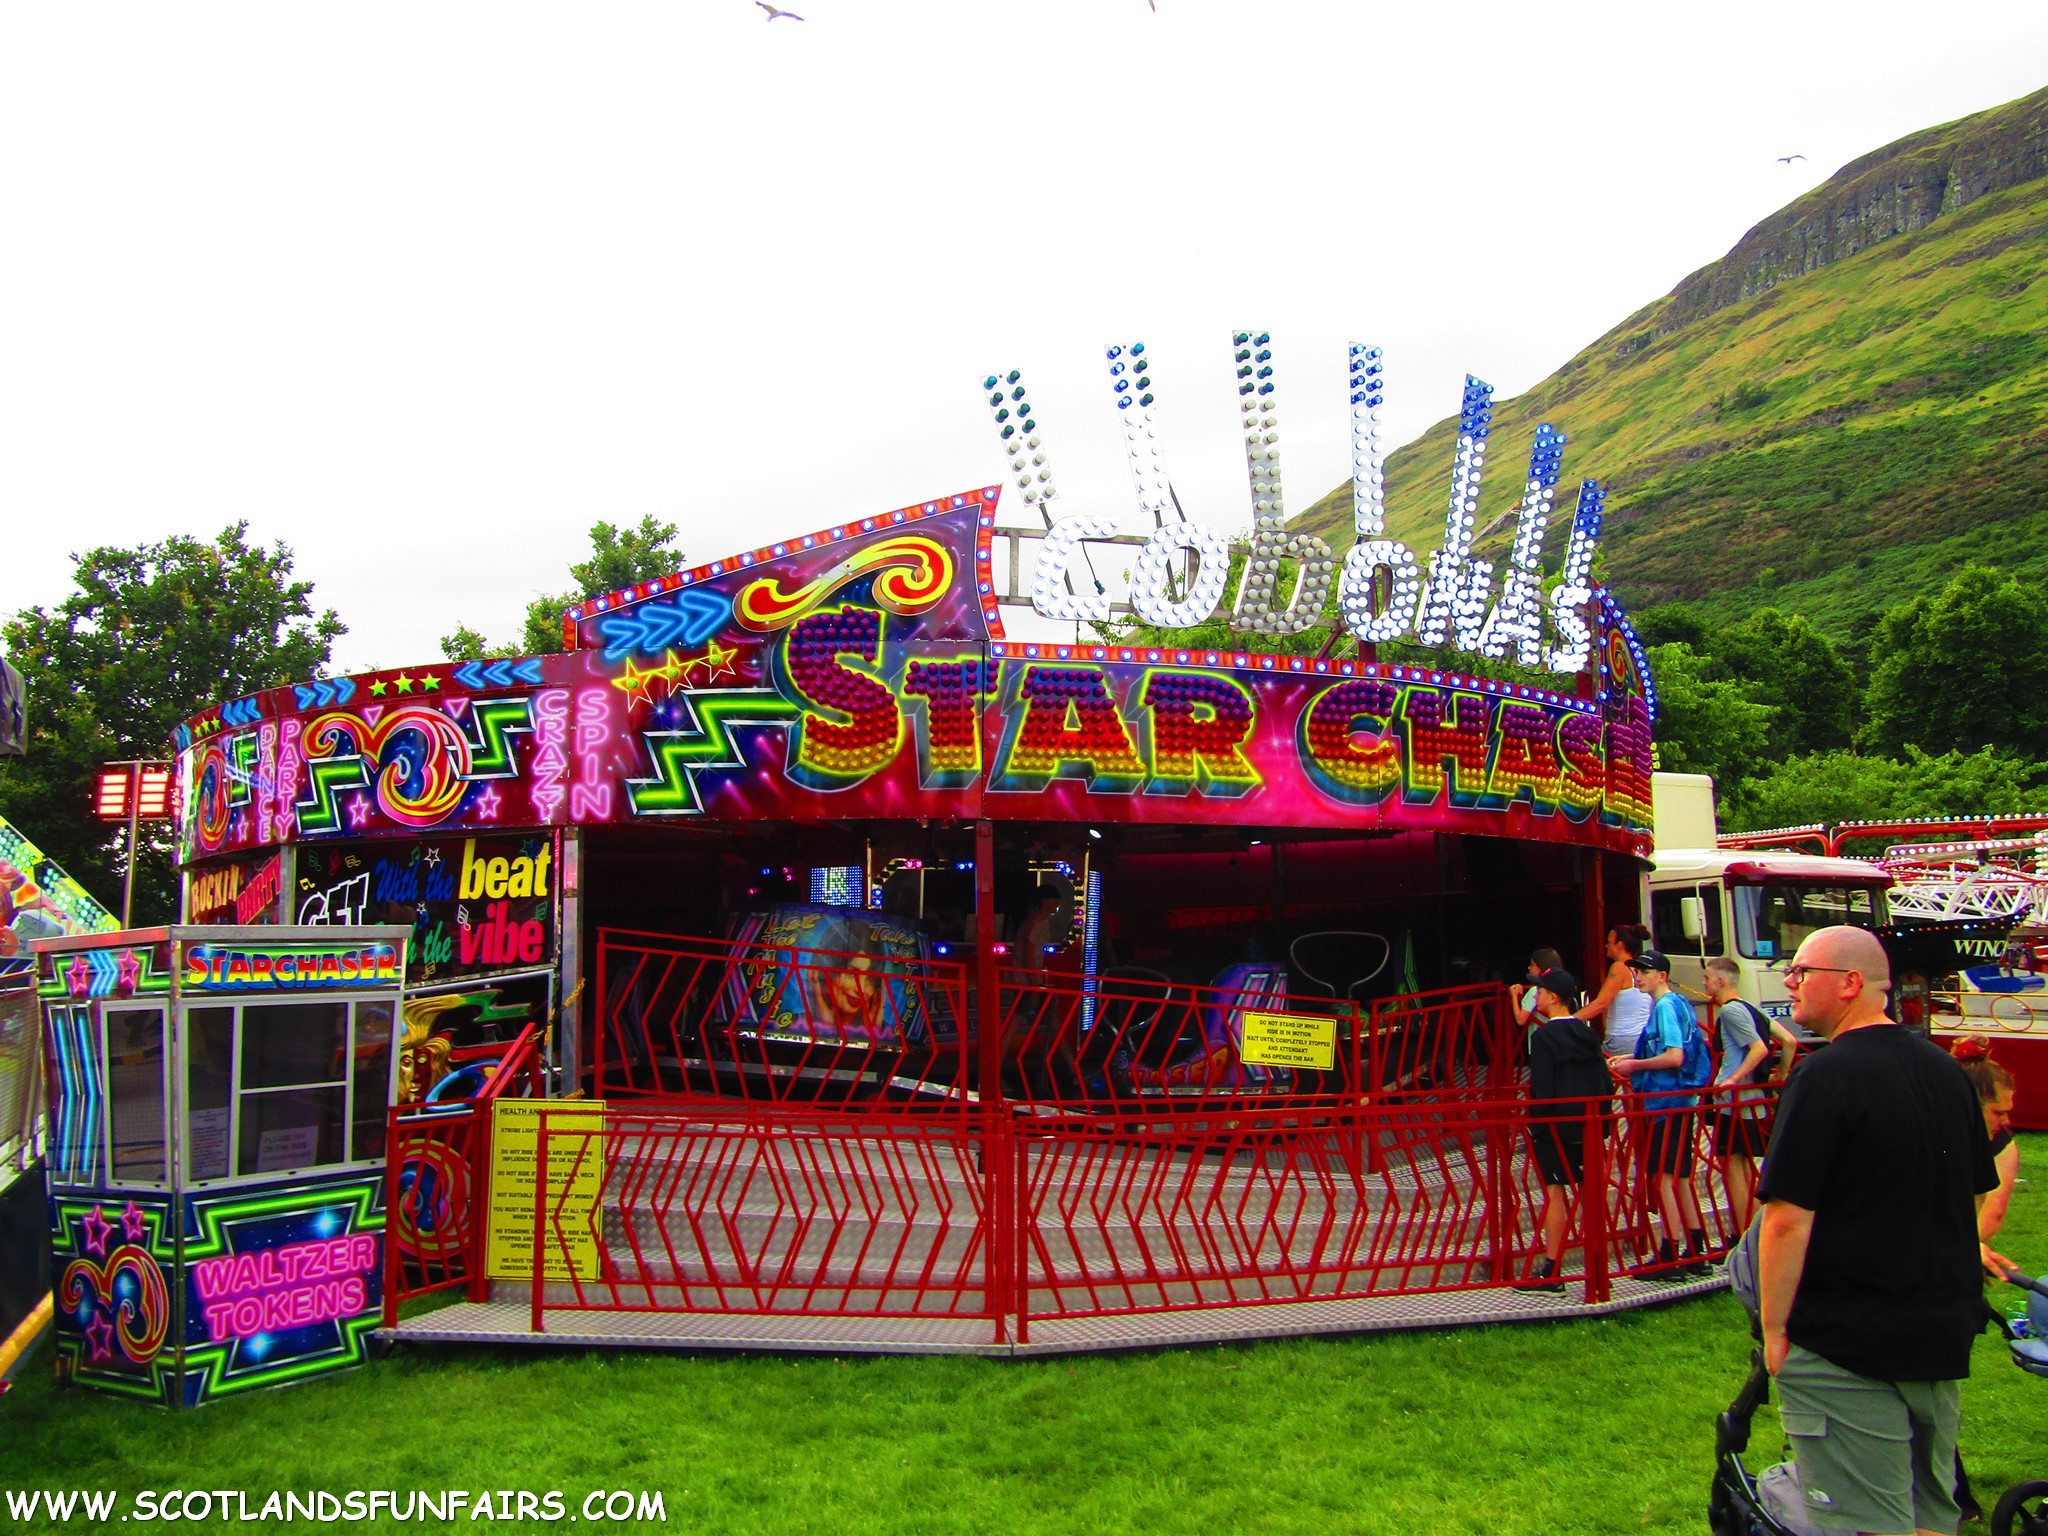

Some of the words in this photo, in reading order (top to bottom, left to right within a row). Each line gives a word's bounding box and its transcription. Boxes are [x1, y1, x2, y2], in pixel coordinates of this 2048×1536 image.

[1031, 515, 1592, 672] CODONAS
[780, 604, 1262, 792] STAR
[257, 722, 278, 843] DANCE
[274, 720, 301, 840] PARTY
[531, 689, 570, 825] CRAZY
[572, 689, 611, 820] SPIN
[191, 864, 239, 918] ROCKIN
[374, 859, 420, 902] With
[424, 858, 454, 901] the
[459, 838, 551, 900] beat
[187, 945, 396, 990] STARCHASER
[423, 920, 452, 964] the
[460, 900, 544, 965] vibe
[196, 1235, 376, 1299] WALTZER
[206, 1277, 365, 1342] TOKENS
